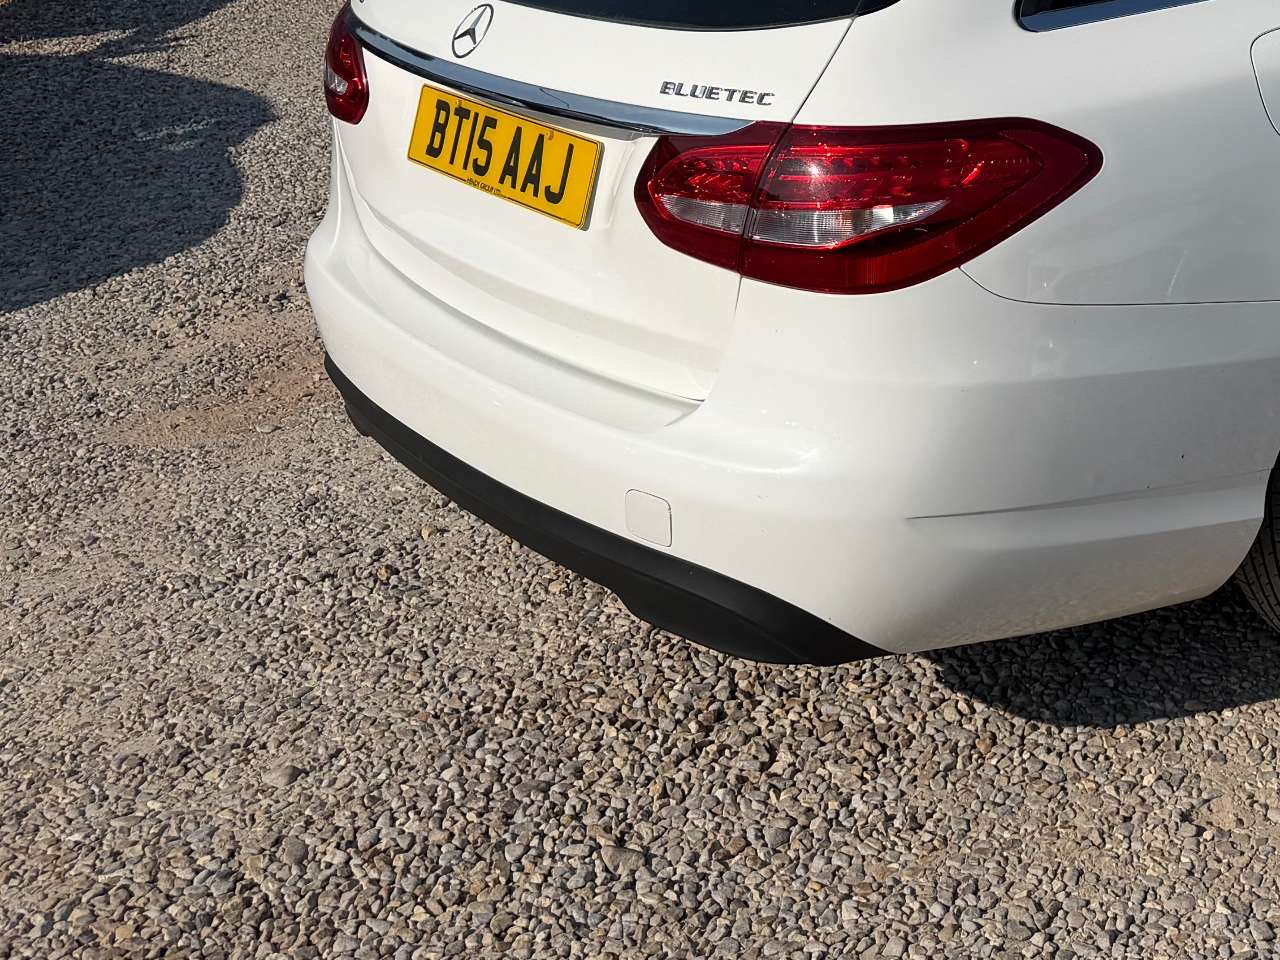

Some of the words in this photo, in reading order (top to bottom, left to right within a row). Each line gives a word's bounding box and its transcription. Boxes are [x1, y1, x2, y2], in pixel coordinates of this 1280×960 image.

[659, 80, 776, 106] BLUETEC
[425, 98, 498, 177] BT15
[498, 125, 575, 205] AAJ
